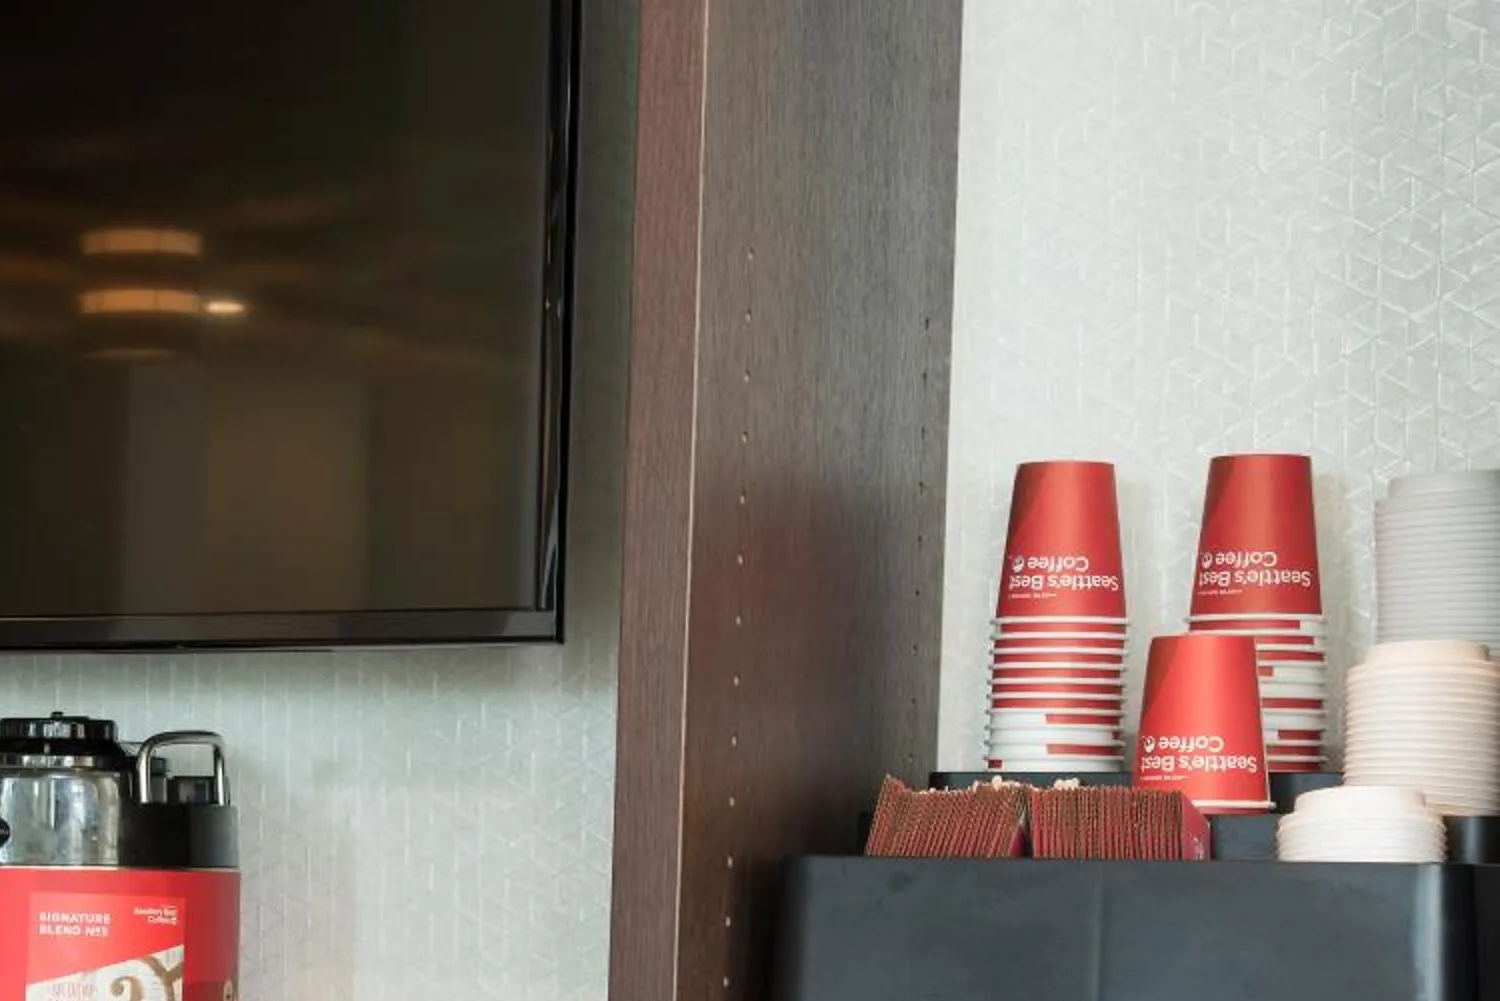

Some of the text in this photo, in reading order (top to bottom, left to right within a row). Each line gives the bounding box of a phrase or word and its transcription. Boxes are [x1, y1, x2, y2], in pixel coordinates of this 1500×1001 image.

[1026, 555, 1090, 573] Coffee
[1214, 550, 1278, 568] Coffee
[1009, 573, 1121, 591] Seattle's Best
[1198, 569, 1312, 588] Seattle's Best
[1158, 735, 1226, 752] Coffee
[1140, 754, 1258, 773] Seattle's Best
[38, 912, 112, 926] SIGNATURE
[38, 924, 81, 936] BLEND
